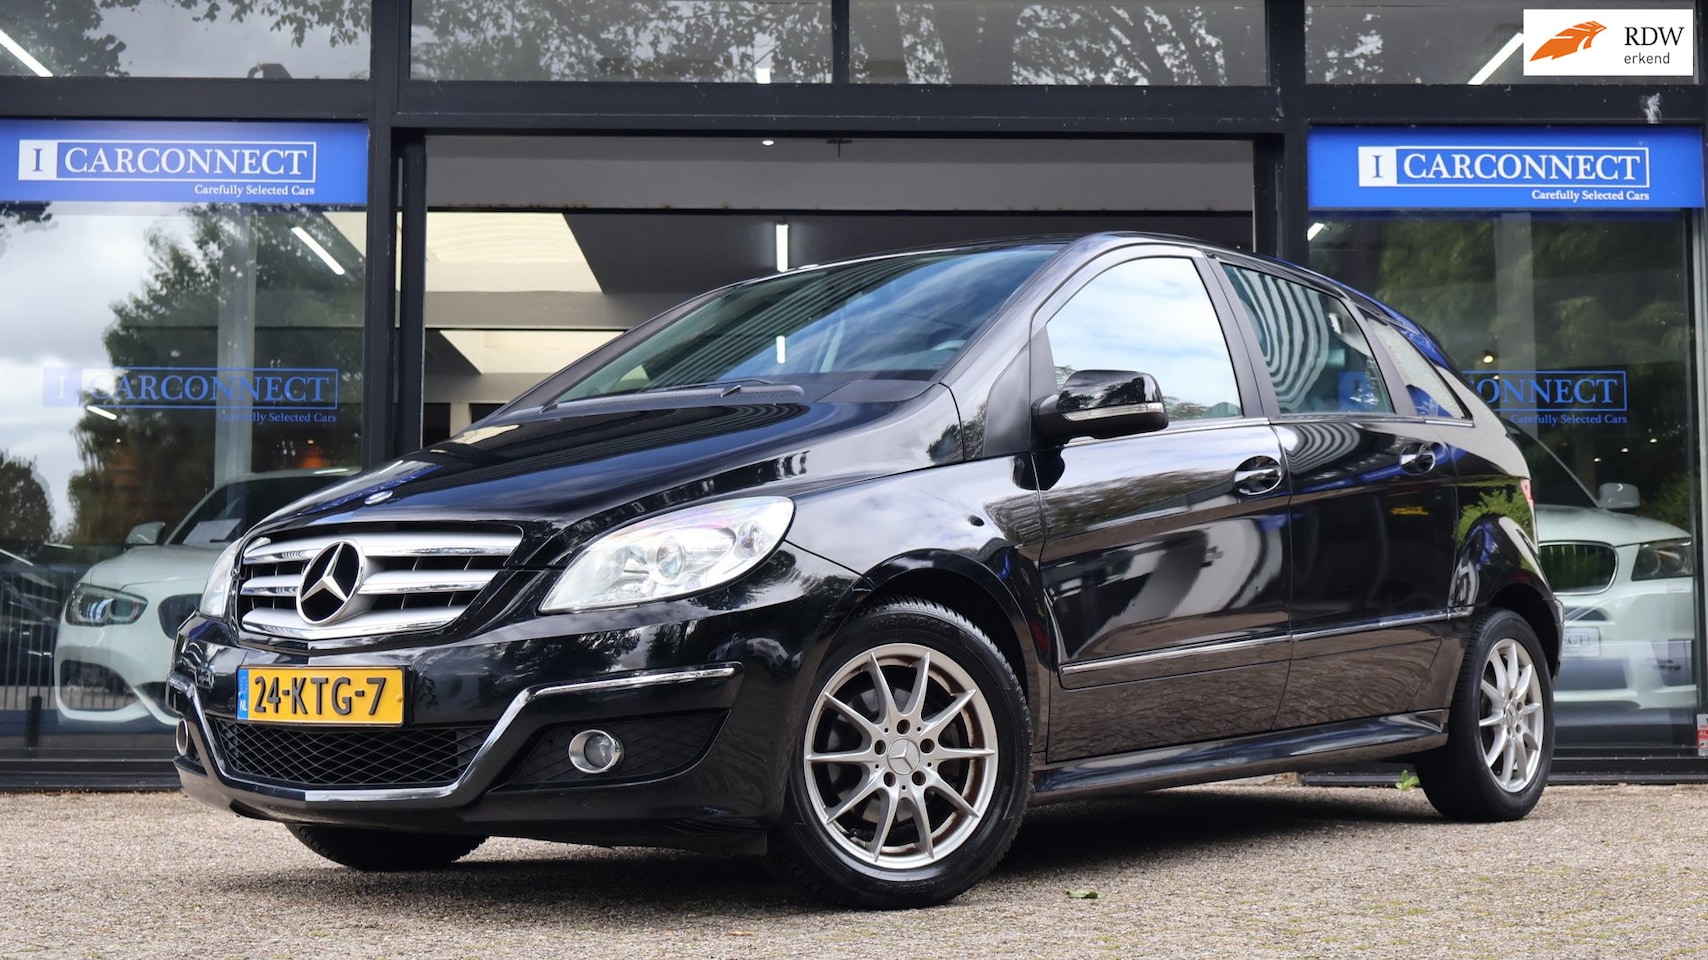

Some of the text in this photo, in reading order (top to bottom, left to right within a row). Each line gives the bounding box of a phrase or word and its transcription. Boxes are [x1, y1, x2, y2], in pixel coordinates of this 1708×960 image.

[32, 147, 307, 176] I CARCONNECT
[1371, 153, 1640, 180] I CARCONNECT
[194, 184, 316, 198] Carefully Selected Cars
[1531, 189, 1650, 203] Carefully Selected Cars
[88, 374, 330, 402] CARCONNECT
[1469, 378, 1618, 404] ONNECT
[268, 412, 311, 423] Selected
[313, 412, 337, 423] Cars
[1510, 414, 1628, 427] Carefully Selected Cars
[254, 675, 387, 716] 24-KTG-7
